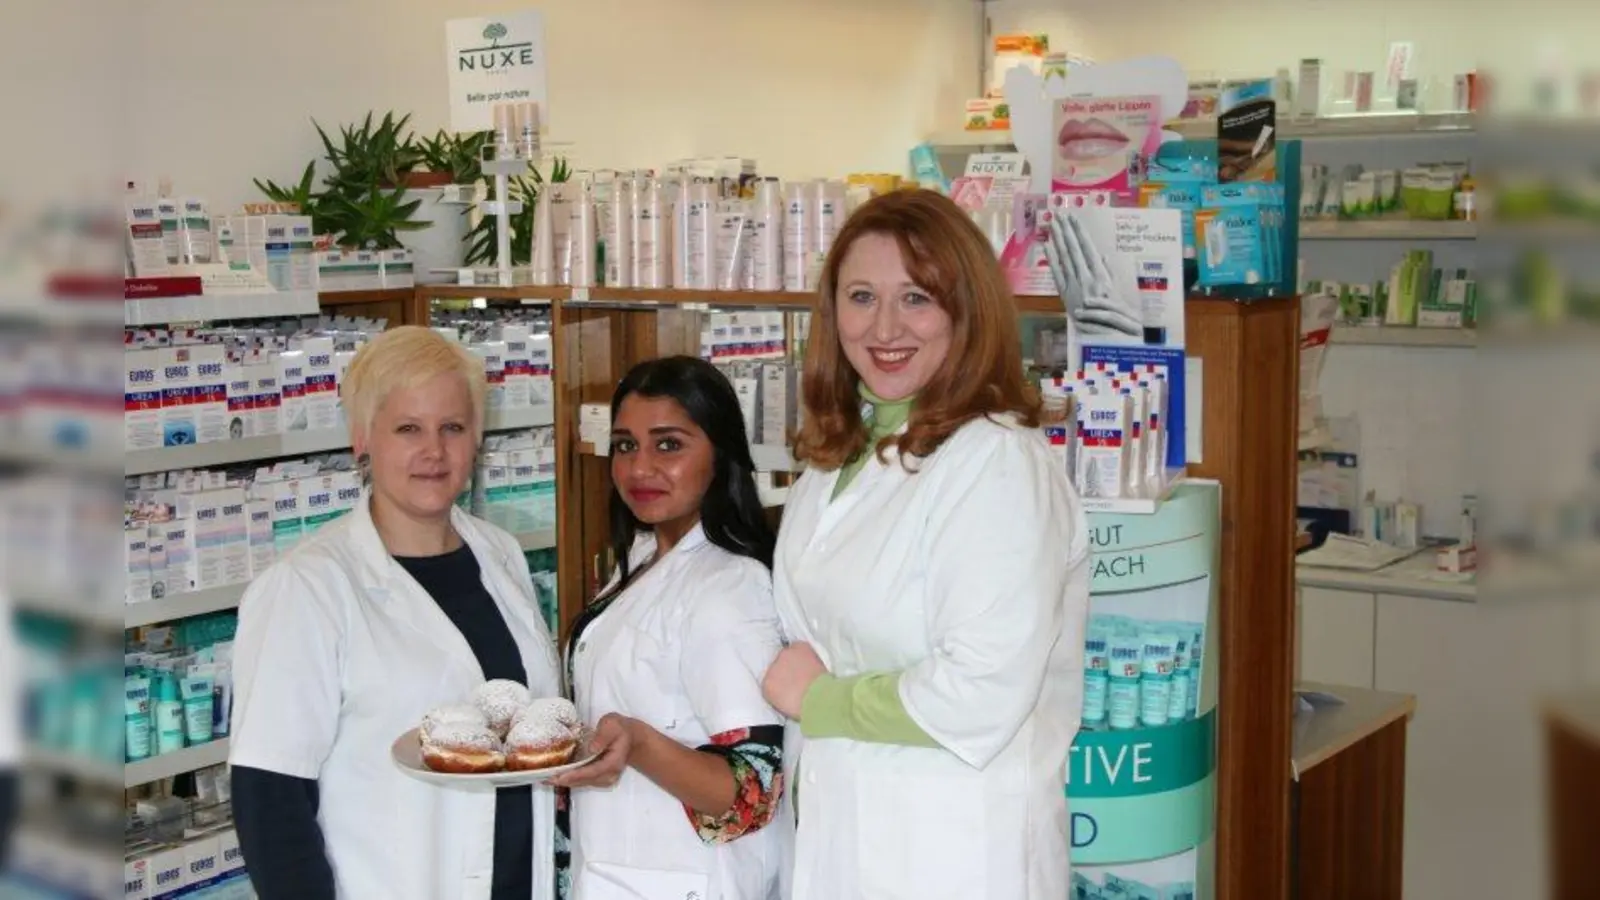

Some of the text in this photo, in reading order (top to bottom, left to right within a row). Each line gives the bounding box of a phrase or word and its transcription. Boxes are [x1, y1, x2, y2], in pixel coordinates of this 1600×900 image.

[459, 48, 534, 72] NUXE
[1090, 554, 1145, 578] ACH
[1065, 742, 1152, 786] TIVE
